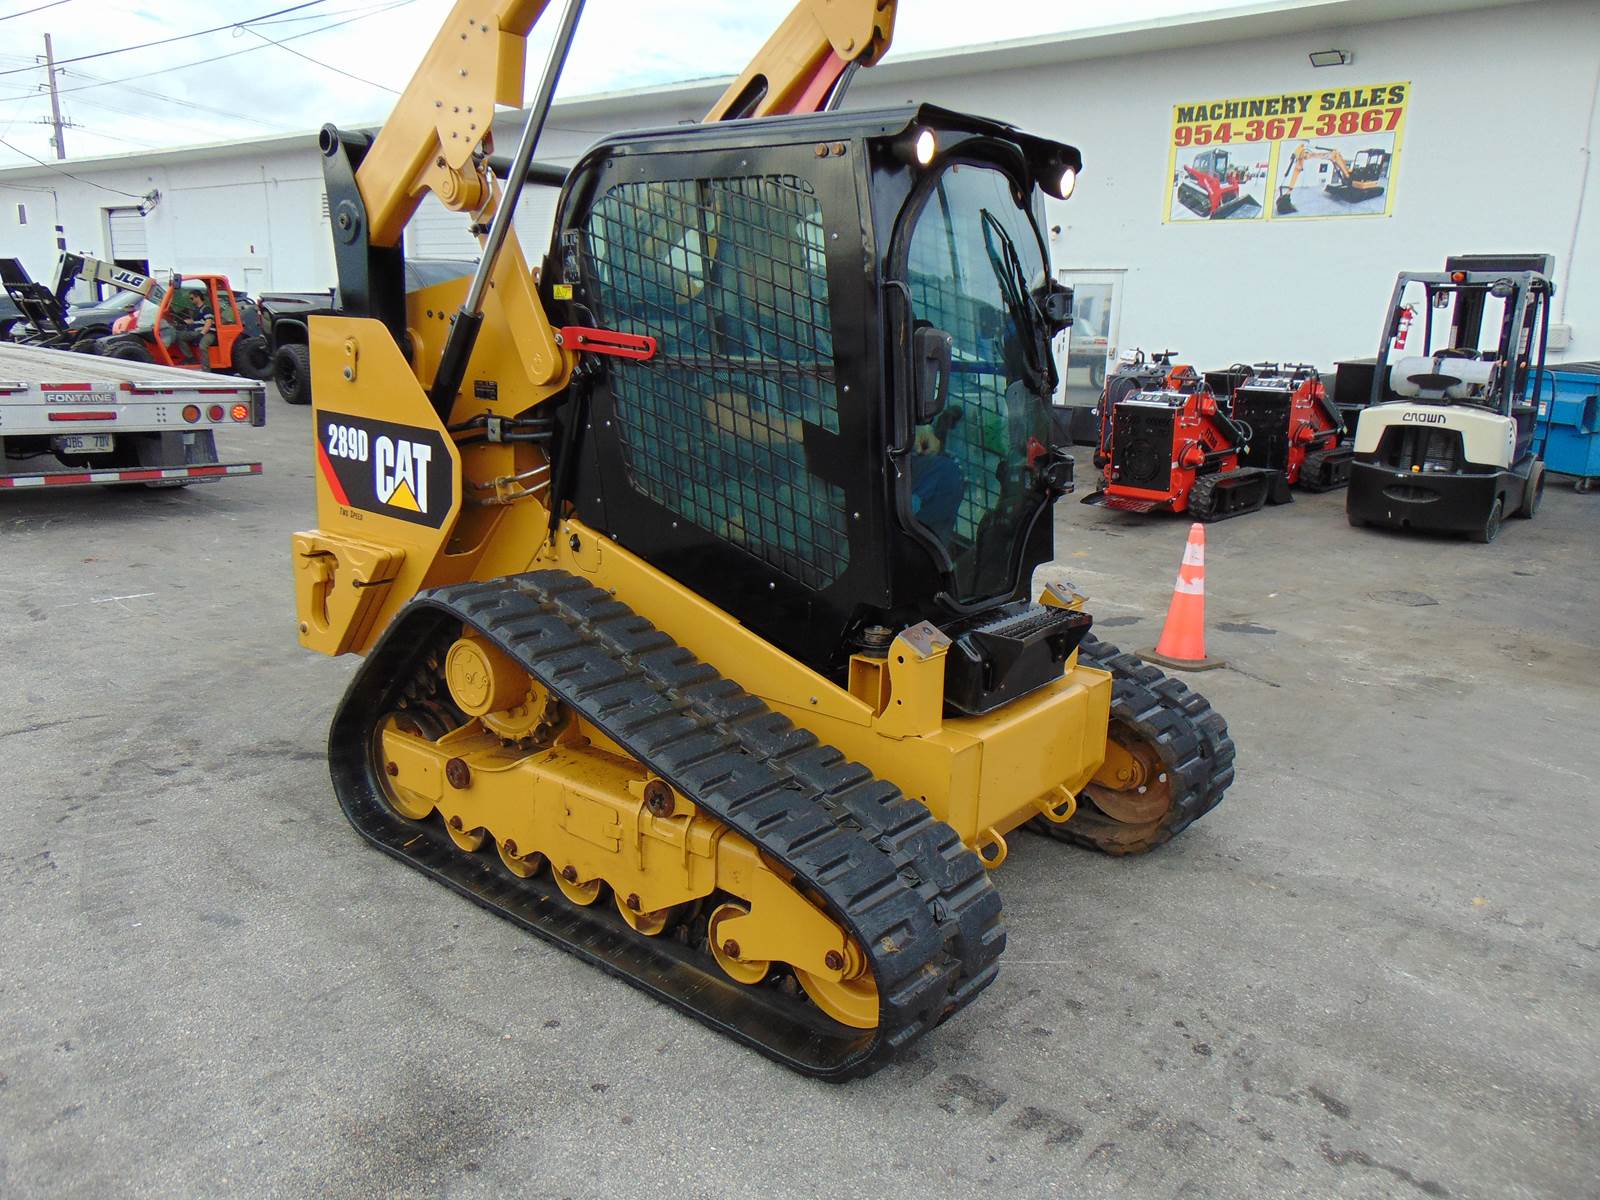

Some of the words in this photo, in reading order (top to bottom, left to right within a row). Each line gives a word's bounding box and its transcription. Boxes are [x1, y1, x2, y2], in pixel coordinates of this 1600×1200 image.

[1177, 95, 1313, 124] MACHINERY
[1320, 85, 1405, 111] SALES
[1174, 107, 1403, 147] 954-367-3867
[114, 271, 144, 287] JLG
[47, 394, 112, 402] FONTAINE
[328, 423, 368, 462] 289D
[375, 435, 432, 514] CAT
[350, 509, 364, 521] SPEED
